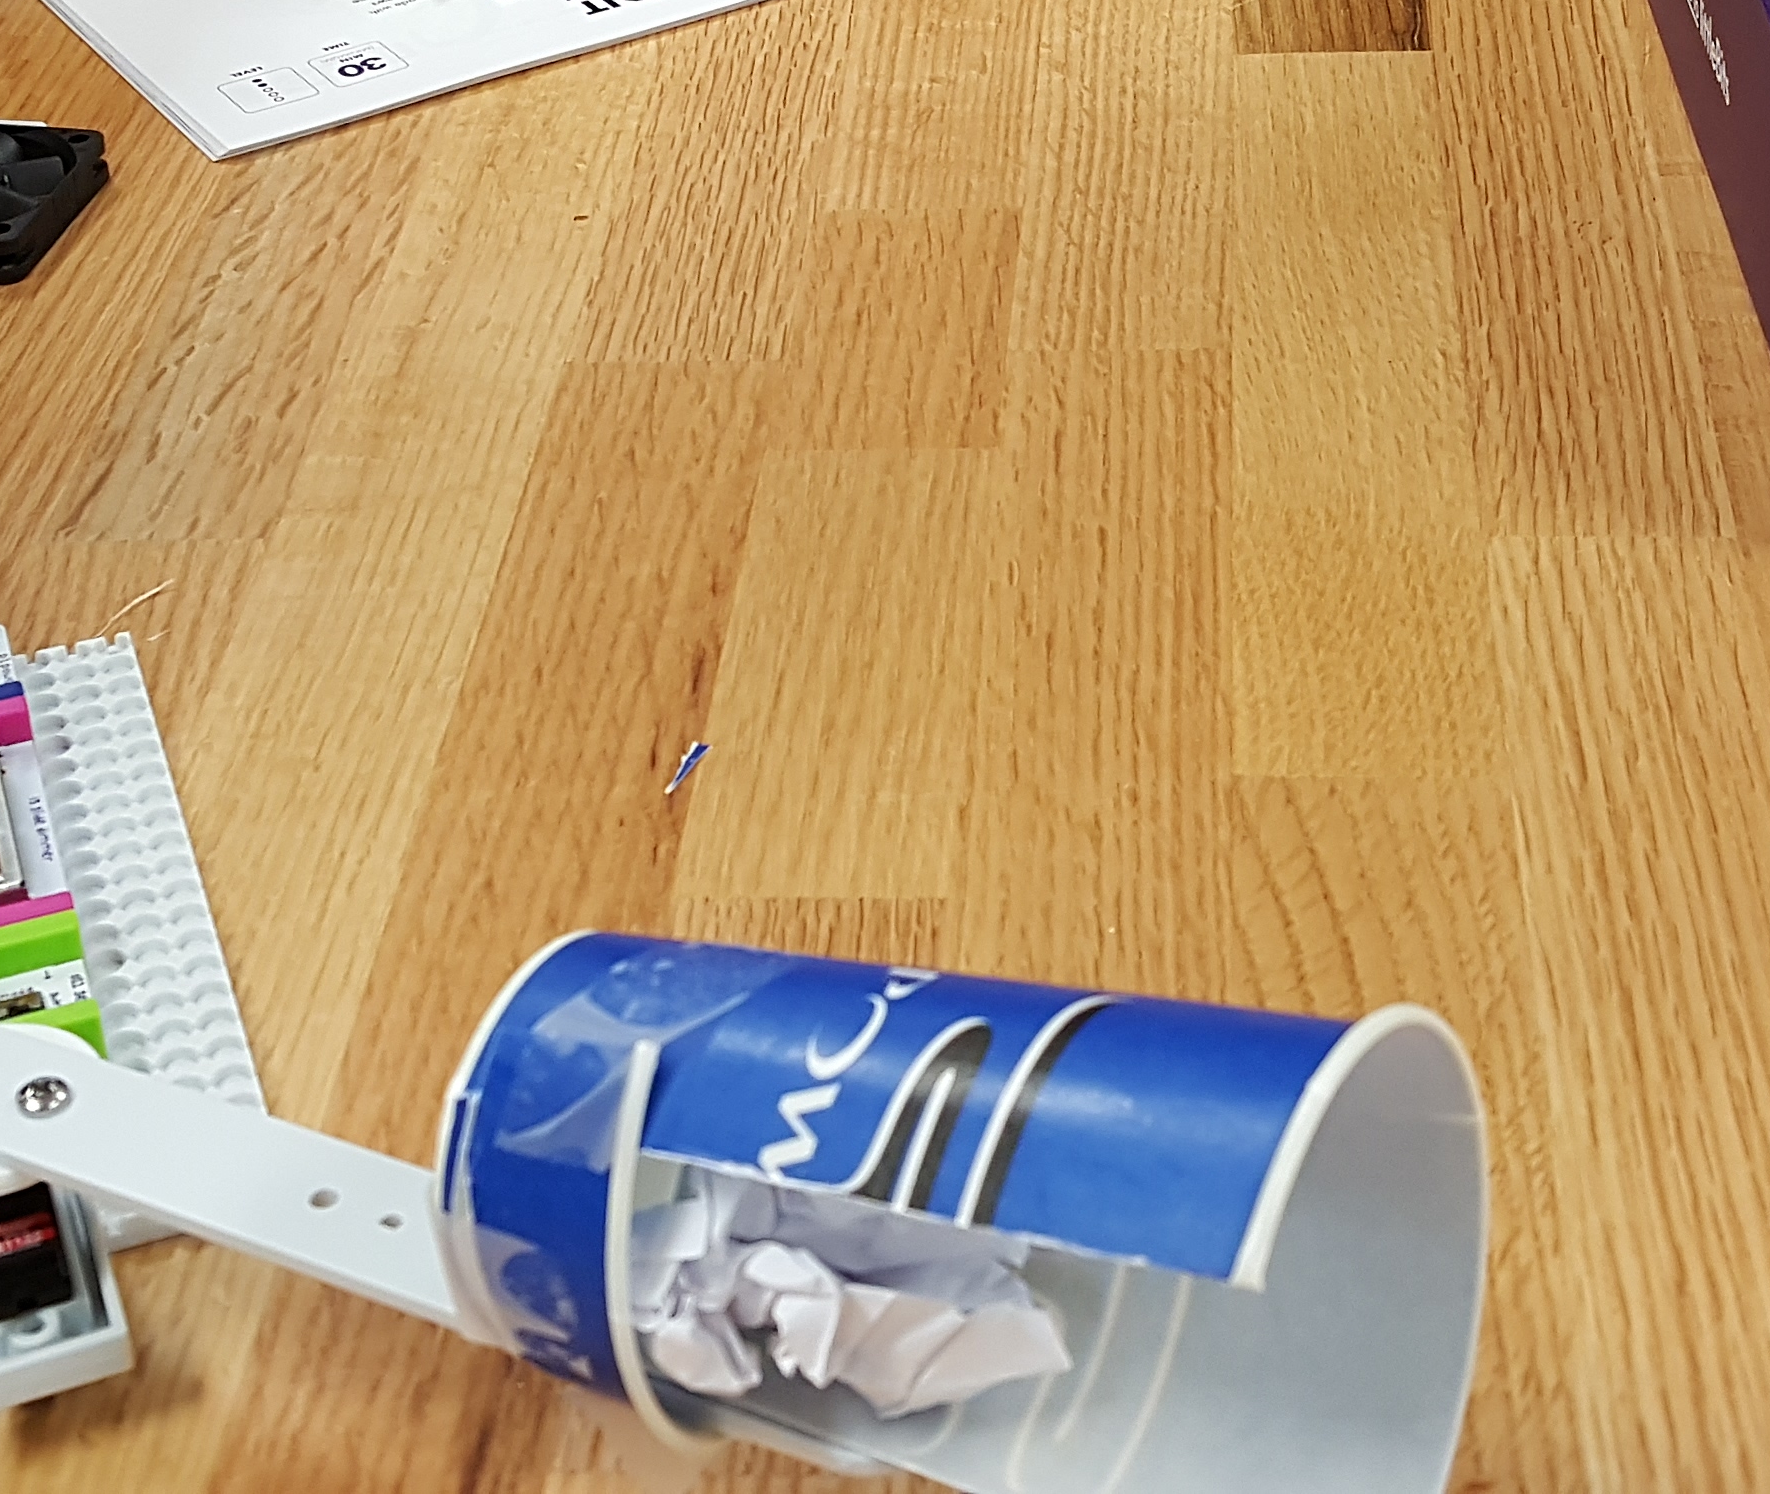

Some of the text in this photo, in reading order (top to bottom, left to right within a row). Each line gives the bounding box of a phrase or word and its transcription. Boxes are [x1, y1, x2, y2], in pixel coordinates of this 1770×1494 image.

[322, 41, 350, 51] TIME
[229, 66, 263, 77] LEVEL
[338, 57, 387, 77] 30
